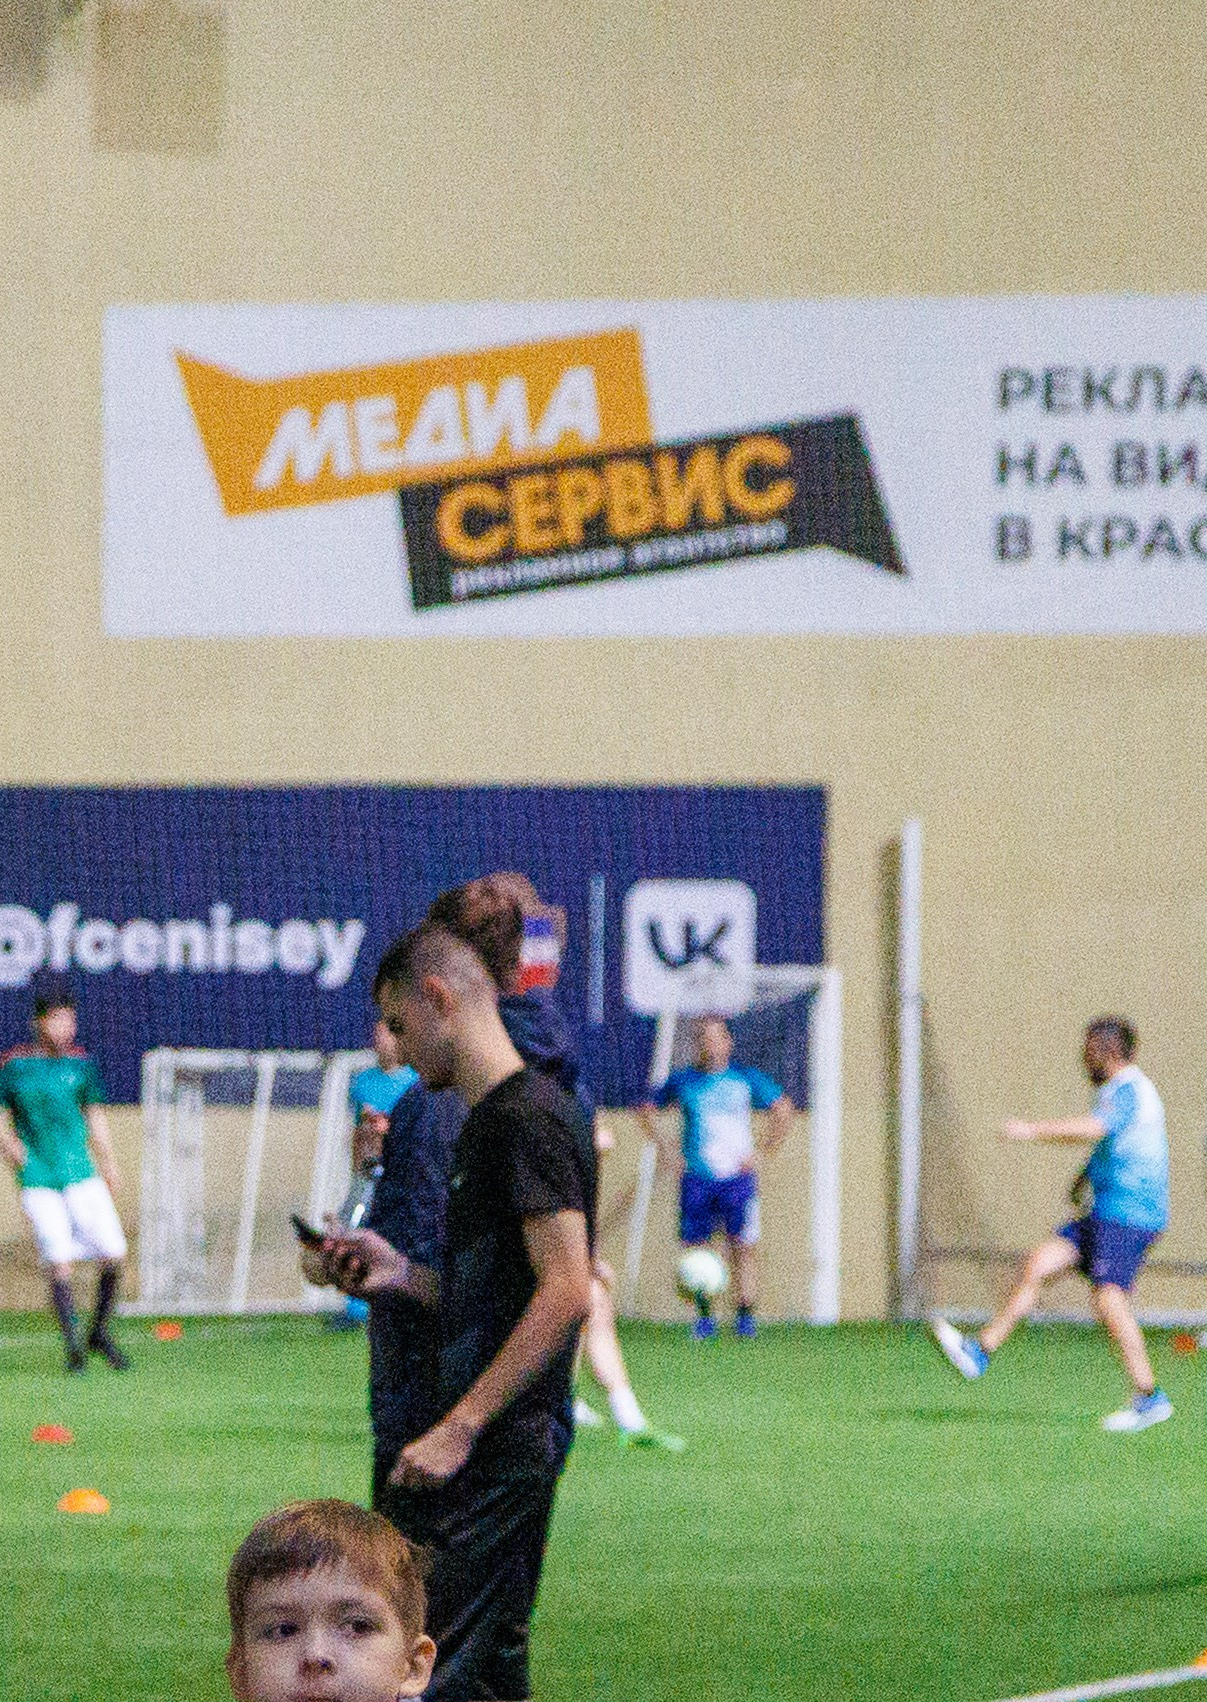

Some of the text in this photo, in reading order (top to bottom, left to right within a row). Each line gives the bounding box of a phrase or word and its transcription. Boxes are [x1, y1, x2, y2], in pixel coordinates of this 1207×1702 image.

[252, 363, 602, 492] МЕДИА
[996, 441, 1207, 489] НА ВИ
[435, 434, 796, 563] СЕРВИС
[997, 514, 1032, 563] В
